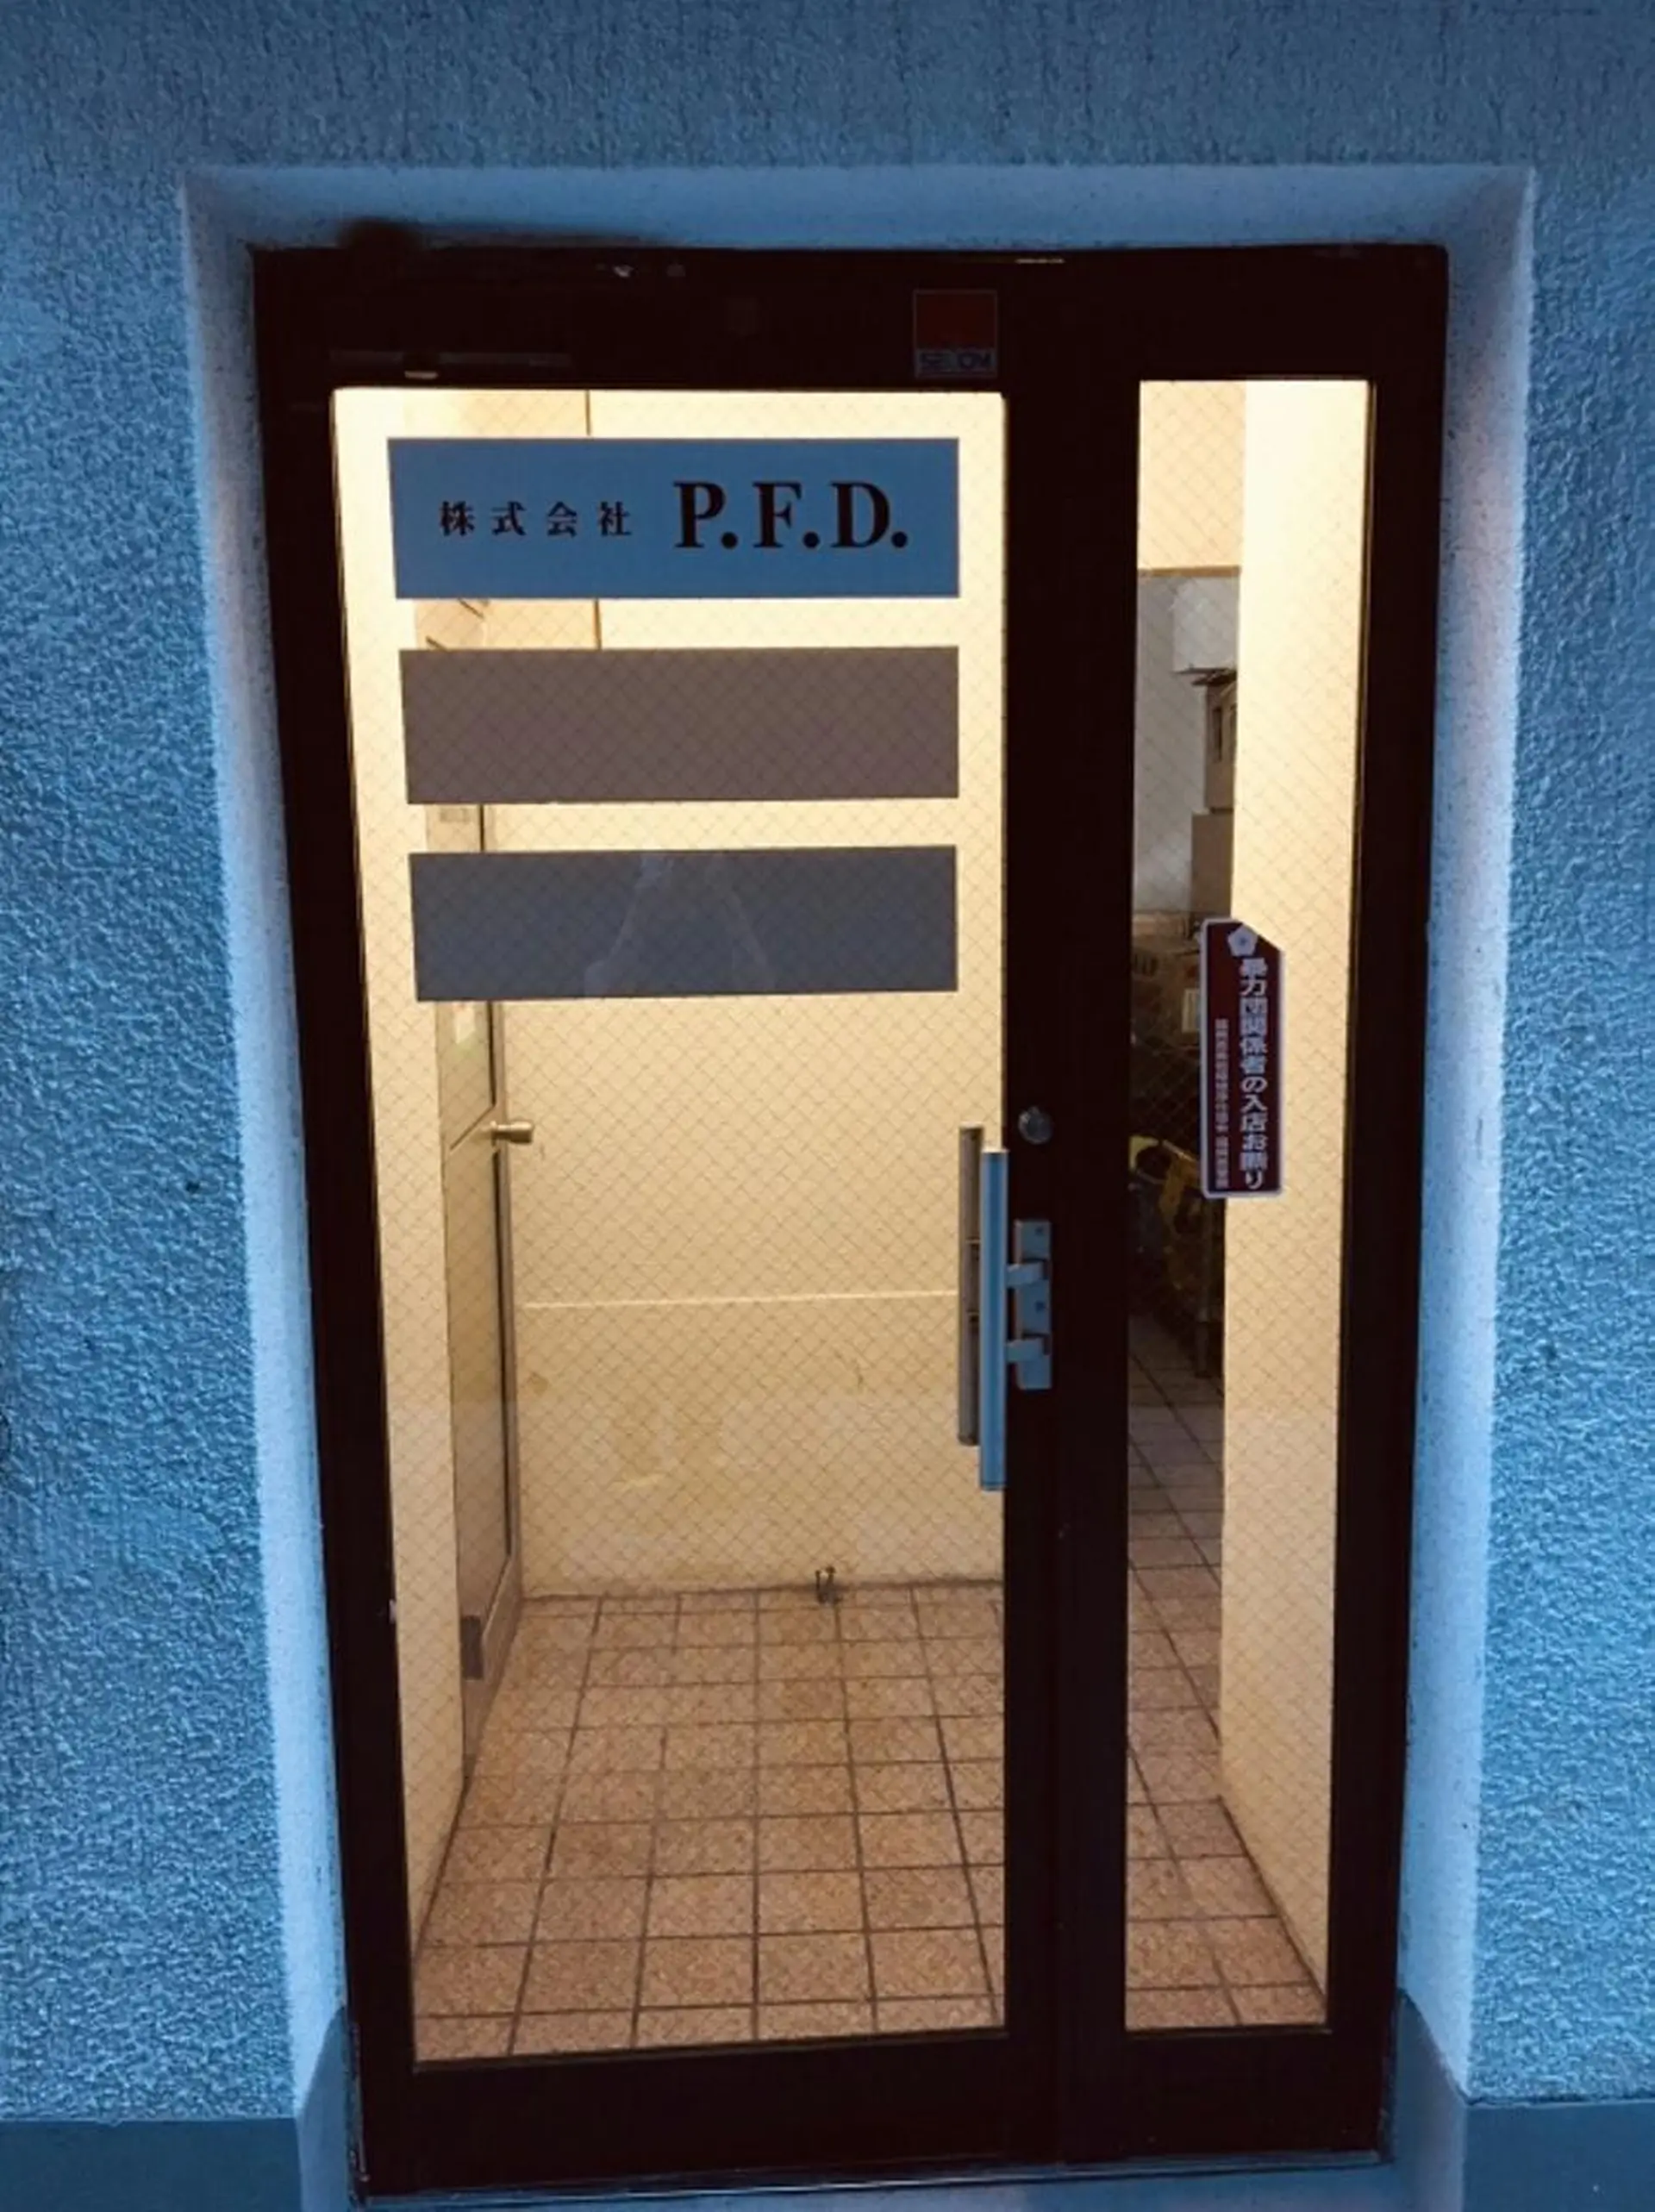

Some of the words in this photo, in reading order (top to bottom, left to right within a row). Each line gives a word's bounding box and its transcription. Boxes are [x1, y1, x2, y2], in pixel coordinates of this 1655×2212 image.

[440, 501, 631, 537] 株式会社
[672, 481, 909, 548] P.F.D.
